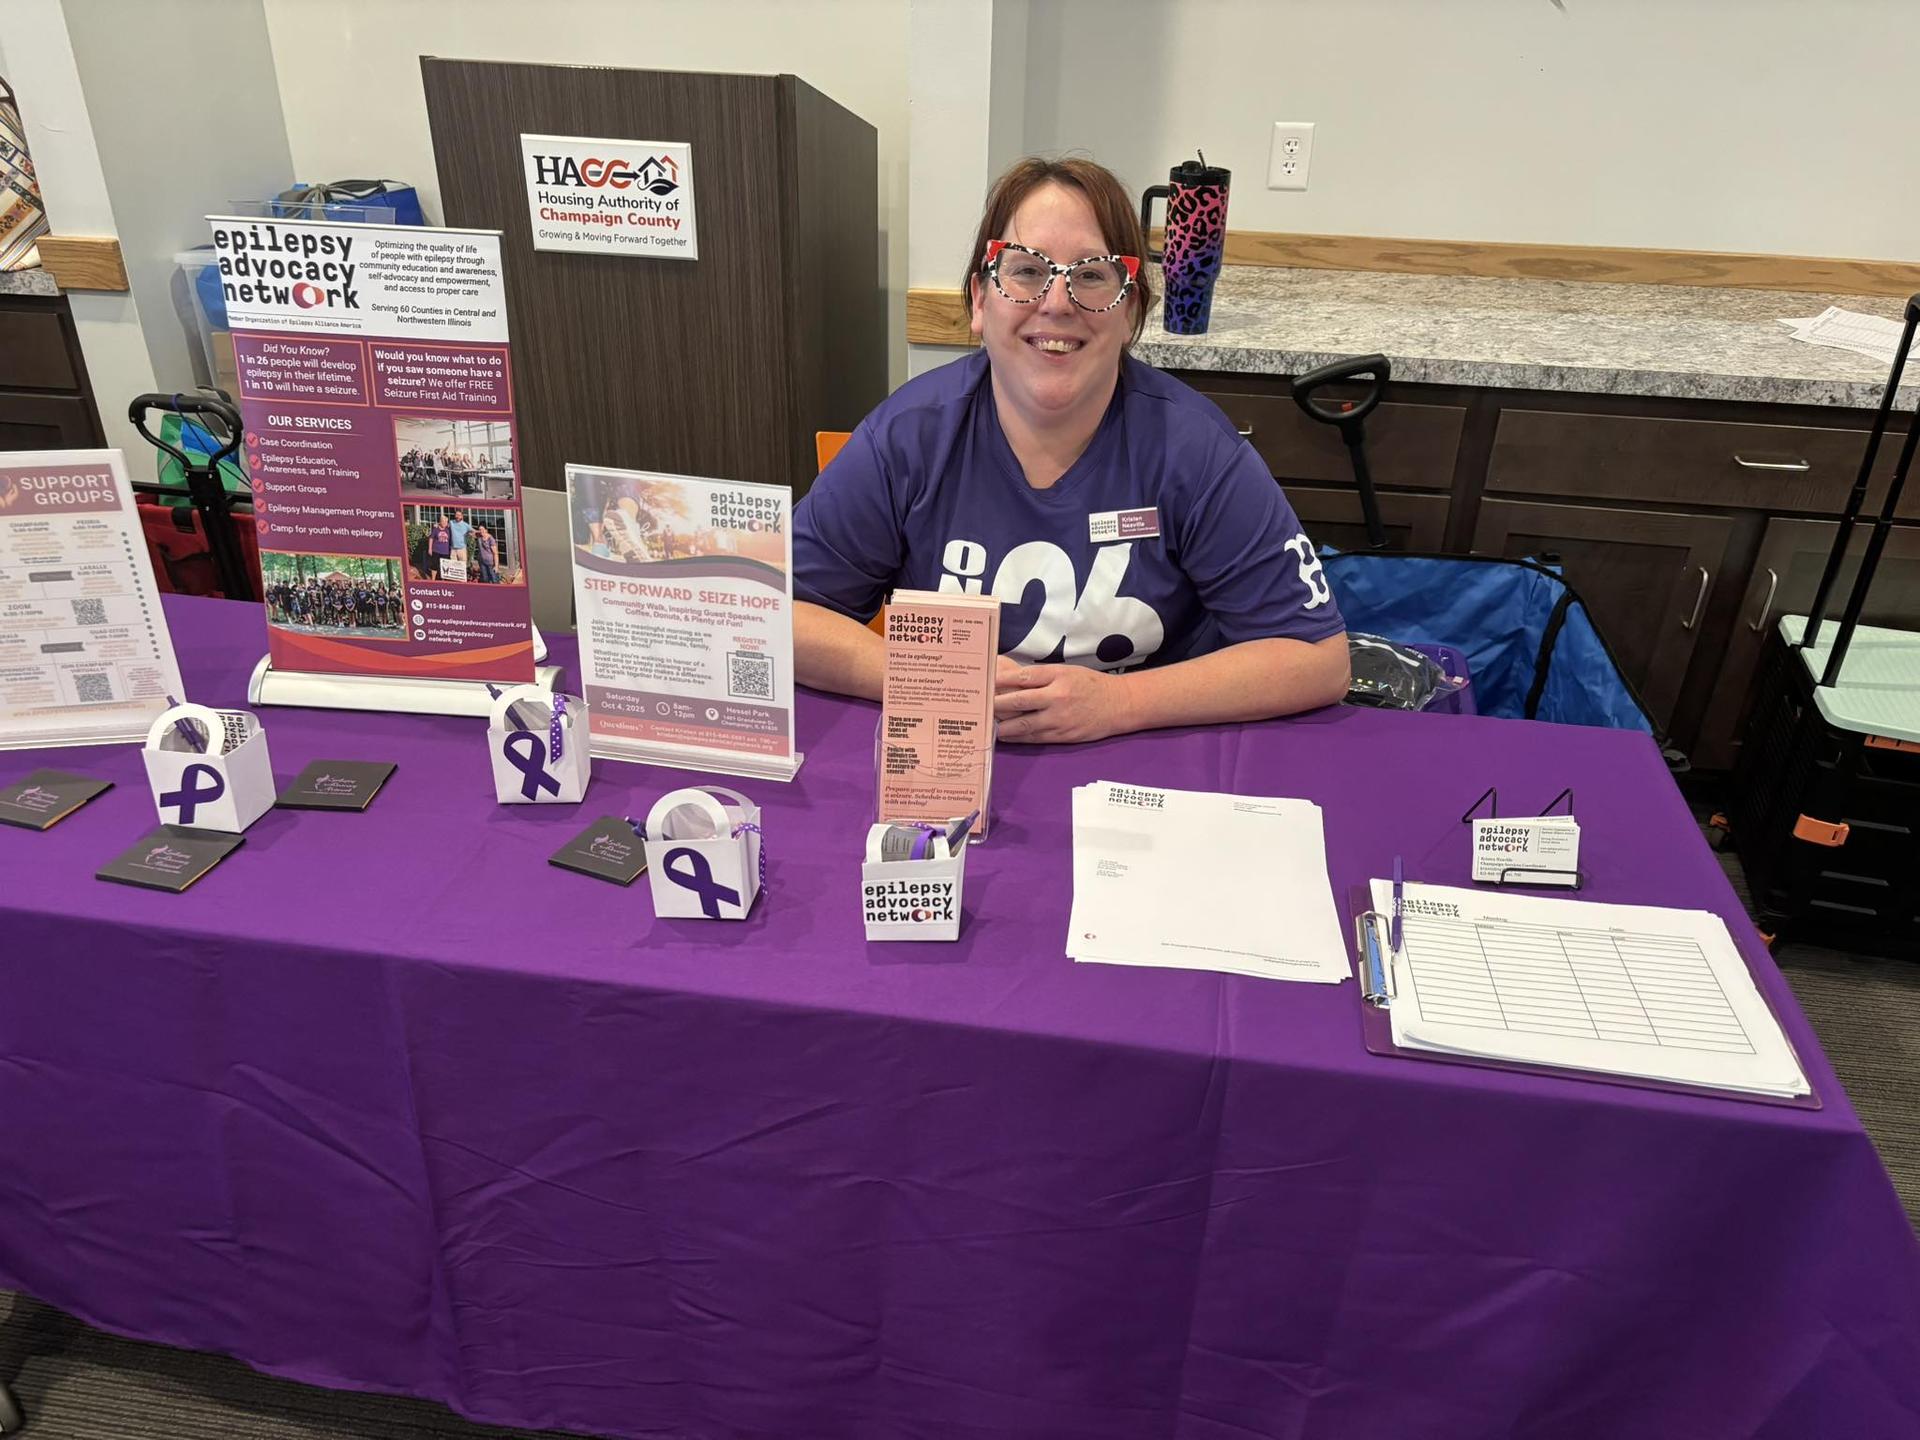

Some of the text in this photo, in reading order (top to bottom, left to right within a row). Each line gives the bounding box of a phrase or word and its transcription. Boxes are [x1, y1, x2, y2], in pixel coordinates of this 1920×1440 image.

[533, 155, 631, 189] HACC
[538, 191, 679, 212] Housing Authority of
[540, 208, 680, 230] Champaign County
[214, 225, 352, 261] epilepsy
[539, 230, 687, 246] Growing & Moving Forward Together
[375, 240, 477, 254] Optimizing the quality of life
[381, 252, 405, 261] people
[407, 253, 422, 261] with
[425, 254, 454, 265] epilepsy
[456, 256, 485, 266] through
[219, 252, 355, 288] advocacy
[360, 262, 497, 276] community education and awareness,
[368, 272, 490, 287] self-advocacy and empowerment,
[223, 279, 360, 309] network
[436, 288, 460, 296] proper
[372, 304, 398, 314] Serving
[411, 306, 443, 315] Counties
[445, 307, 451, 315] in
[453, 308, 480, 317] Central
[481, 309, 496, 317] and
[397, 316, 472, 327] Northwestern Illinois
[263, 344, 330, 356] Did You Know?
[240, 355, 356, 372] 1 in 26 people will develop
[375, 350, 501, 365] Would you know what to do
[247, 368, 354, 382] epilepsy in their lifetime.
[377, 363, 384, 371] if
[386, 365, 403, 374] you
[426, 367, 468, 376] someone
[470, 368, 493, 377] have
[245, 380, 249, 388] 1
[252, 380, 260, 389] in
[262, 381, 273, 390] 10
[275, 383, 290, 391] will
[293, 383, 314, 393] have
[325, 386, 360, 395] seizure.
[388, 377, 494, 390] seizure? We offer FREE
[384, 388, 496, 404] Seizure First Aid Training
[268, 415, 352, 430] OUR SERVICES
[260, 438, 333, 449] Case Coordination
[262, 454, 338, 466] Epilepsy Education,
[264, 465, 360, 479] Awareness, and Training
[20, 474, 110, 490] SUPPORT
[265, 482, 327, 494] Support Groups
[34, 490, 115, 505] GROUPS
[710, 491, 781, 511] epilepsy
[268, 504, 394, 519] Epilepsy Management Programs
[711, 504, 781, 522] advocacy
[271, 524, 383, 539] Camp for youth with epilepsy
[1284, 533, 1330, 610] B
[410, 588, 454, 597] Contact Us:
[584, 578, 780, 611] STEP FORWARD SEIZE HOPE
[602, 597, 765, 623] Community Walk, Inspiring Guest Speakers,
[991, 540, 1165, 668] 26
[625, 608, 652, 618] Coffee,
[654, 611, 682, 621] Donuts,
[692, 615, 715, 625] Plenty
[889, 613, 944, 626] epilepsy
[889, 623, 943, 635] advocacy
[601, 701, 615, 709] Oct
[606, 692, 640, 704] Saturday
[673, 703, 692, 711] 8am-
[726, 706, 769, 718] Hessel Park
[674, 711, 695, 719] 12pm
[1110, 788, 1165, 799] epilepsy
[1110, 793, 1164, 803] advocacy
[1481, 825, 1530, 836] epilepsy
[1479, 835, 1529, 846] advocacy
[865, 881, 952, 897] epilepsy
[866, 896, 952, 910] advocacy
